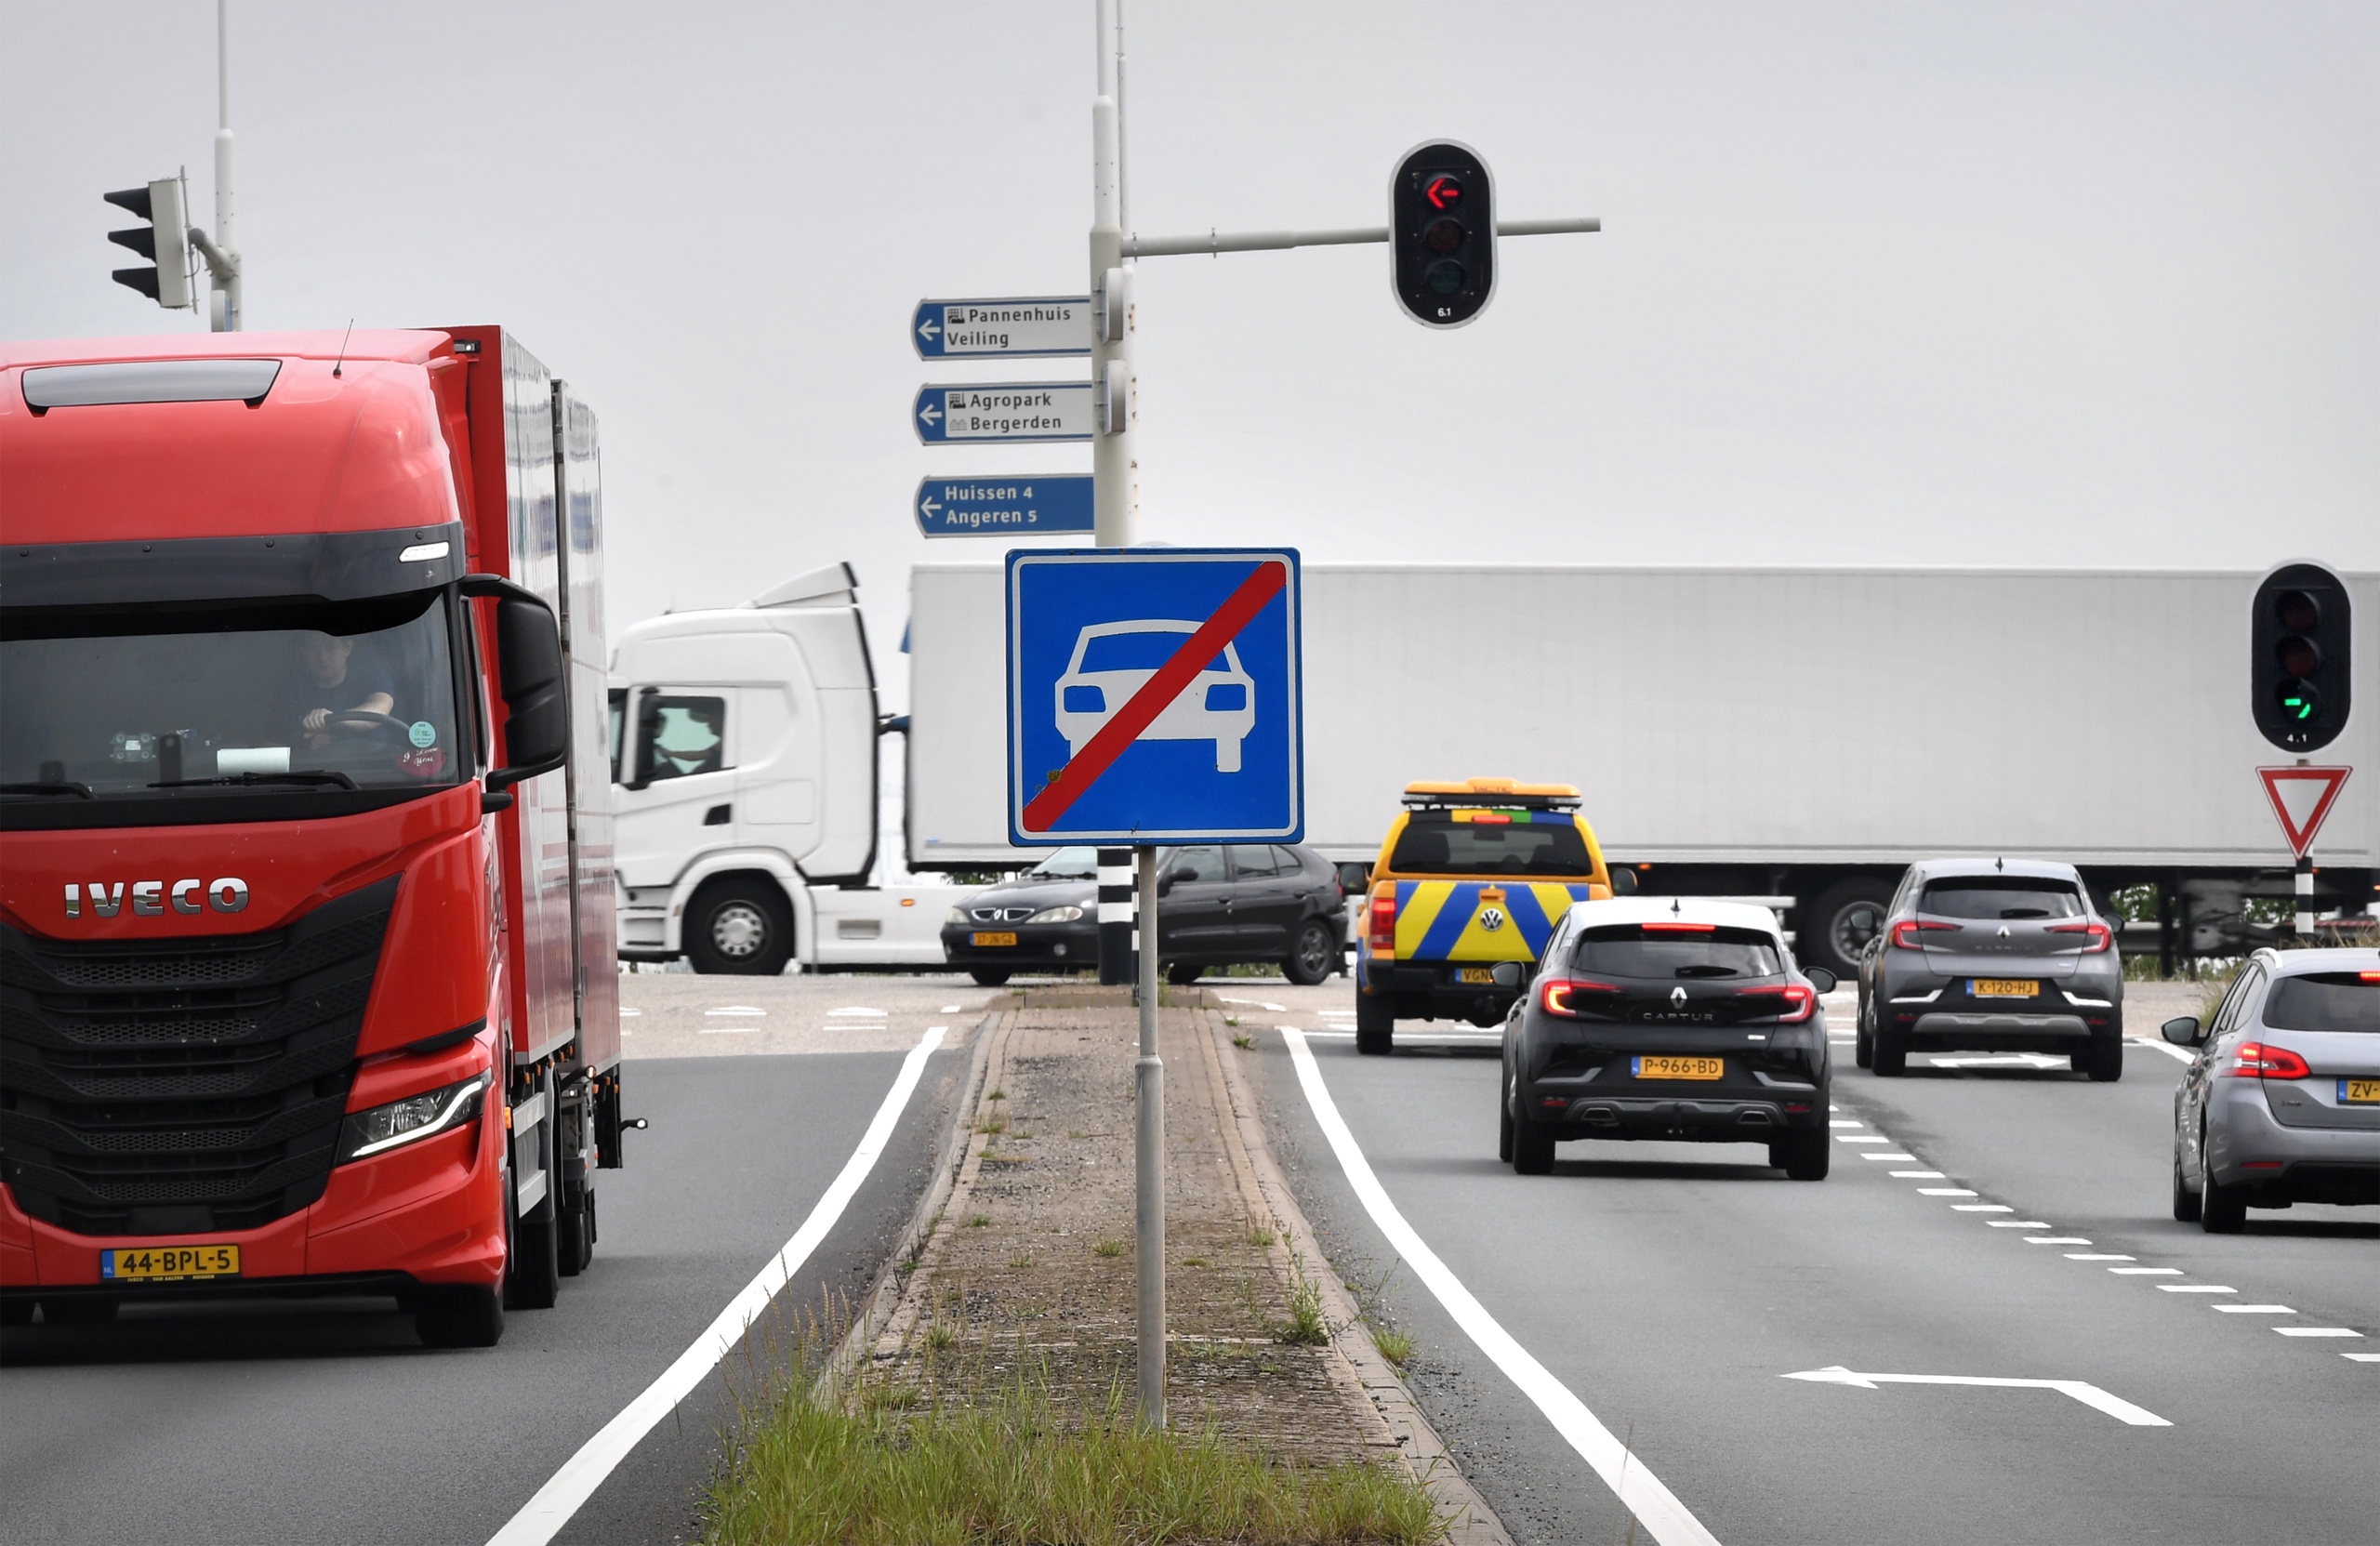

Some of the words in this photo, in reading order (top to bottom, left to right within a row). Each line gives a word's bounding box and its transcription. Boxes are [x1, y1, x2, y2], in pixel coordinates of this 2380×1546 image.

[969, 307, 1071, 323] Pannenhuis
[1437, 307, 1451, 317] 6.1
[947, 331, 1009, 348] Veiling
[971, 392, 1051, 410] Agropark
[971, 416, 1062, 433] Bergerden
[945, 486, 1017, 500] Huissen
[1023, 486, 1033, 498] 4
[945, 509, 1022, 527] Angeren
[1027, 509, 1038, 522] 5
[65, 877, 249, 919] IVECO
[1978, 982, 2033, 994] K-120-HJ
[1643, 1012, 1713, 1021] CAPTUR
[1645, 1059, 1719, 1074] P-966-BD
[123, 1249, 231, 1273] 44-BPL-5
